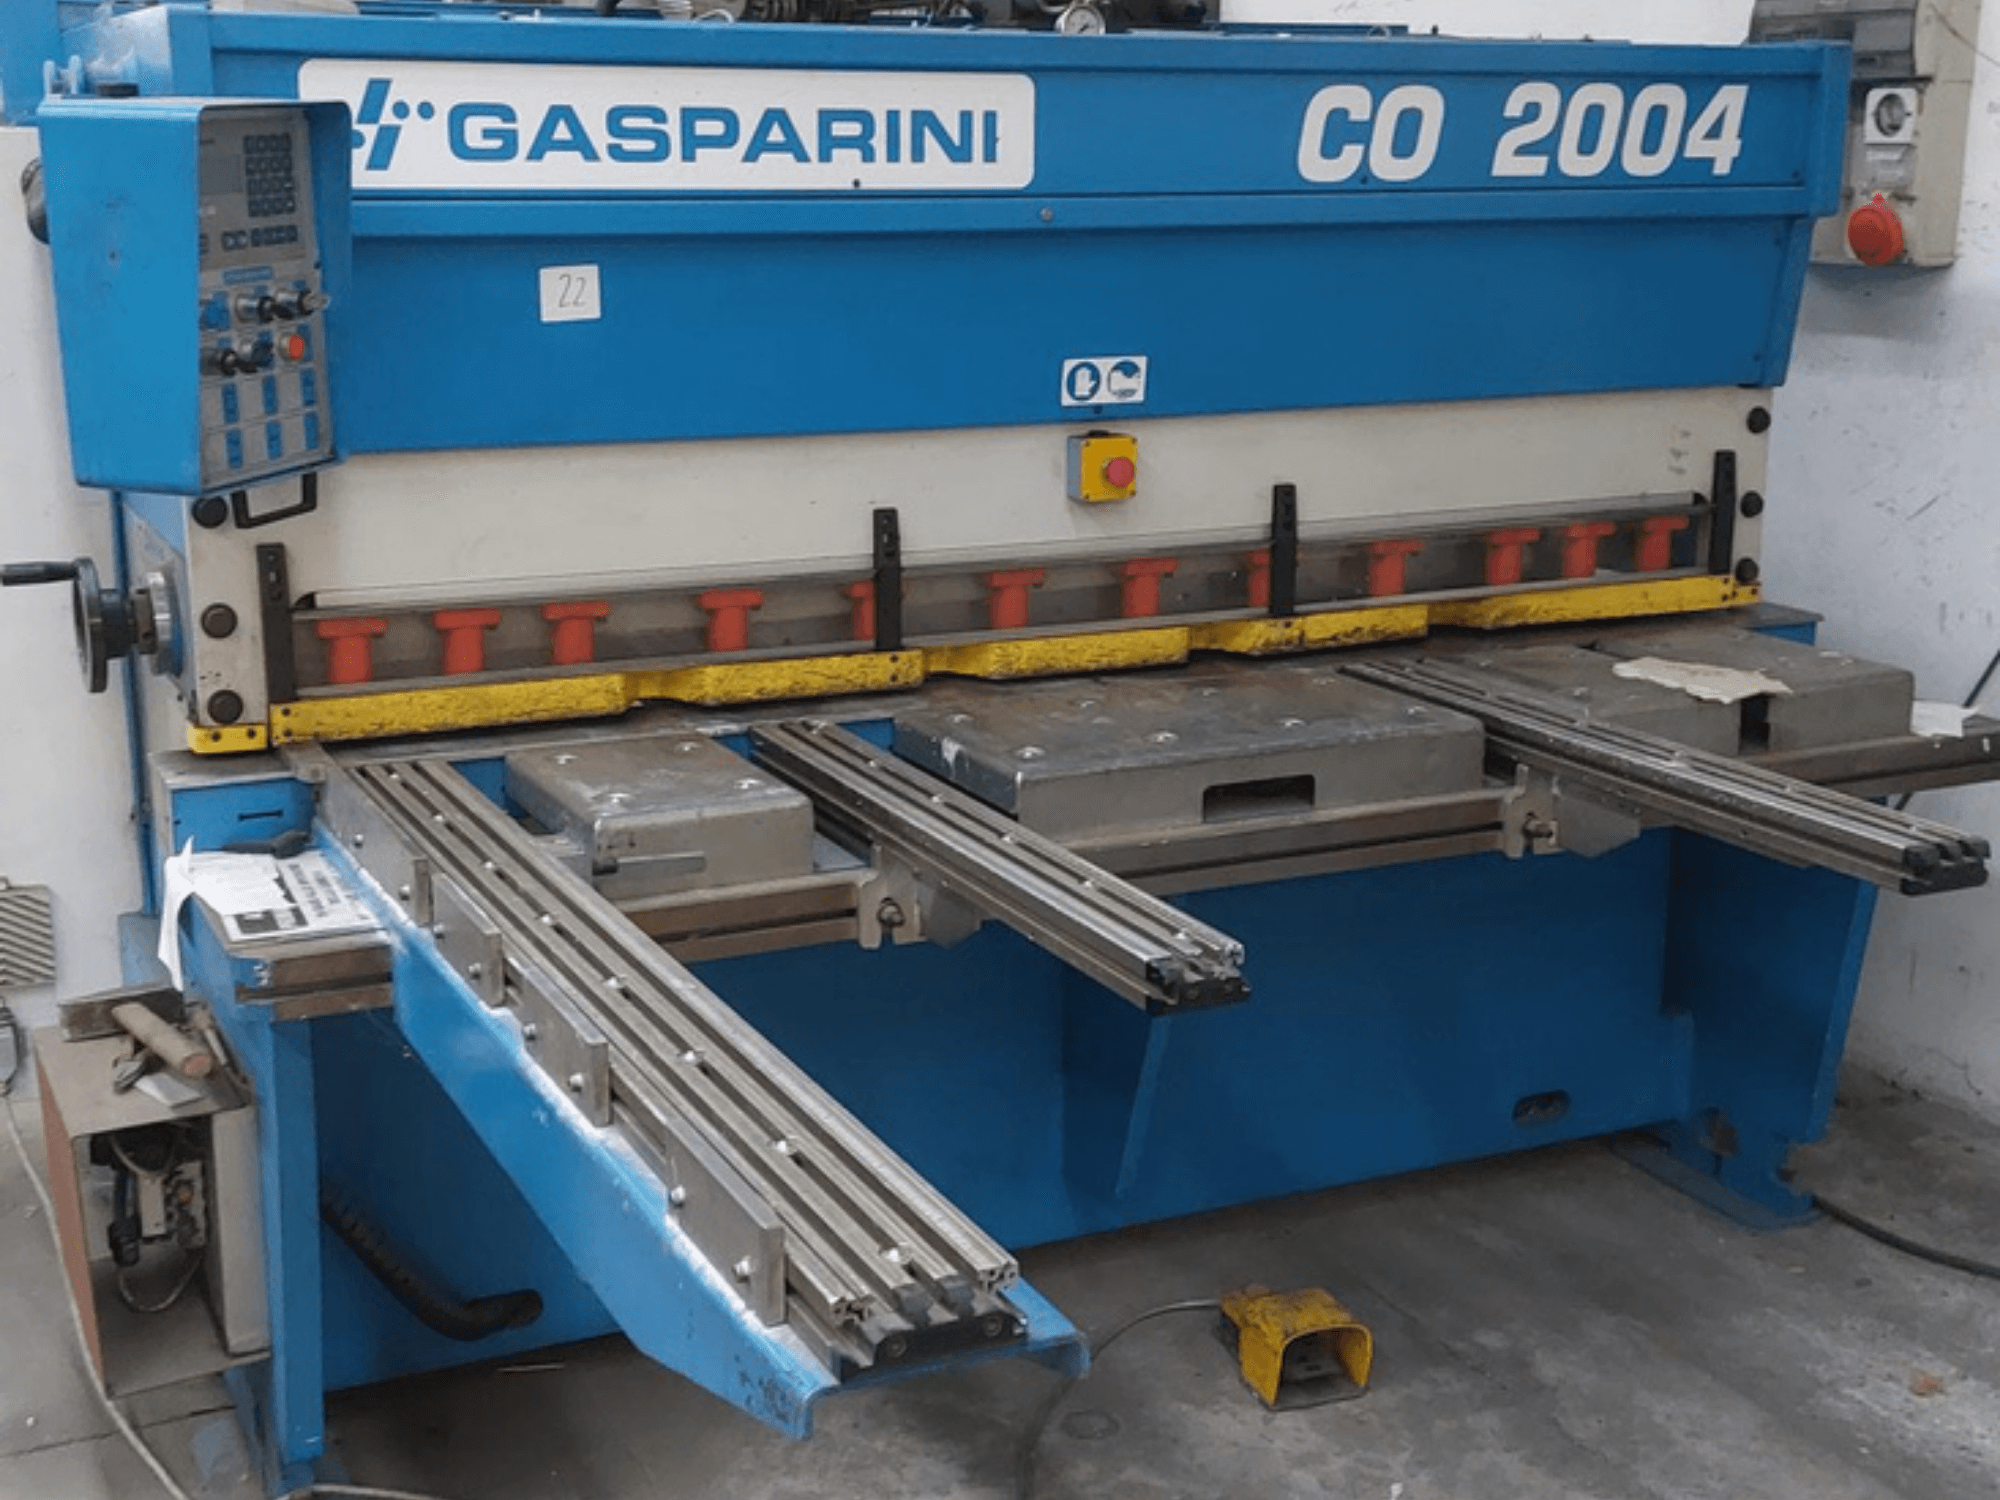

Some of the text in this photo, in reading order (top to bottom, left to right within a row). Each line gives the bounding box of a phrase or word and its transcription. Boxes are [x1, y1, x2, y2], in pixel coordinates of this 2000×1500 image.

[447, 102, 998, 163] GASPARINI
[1297, 82, 1749, 183] CO 2004
[558, 273, 587, 308] 22
